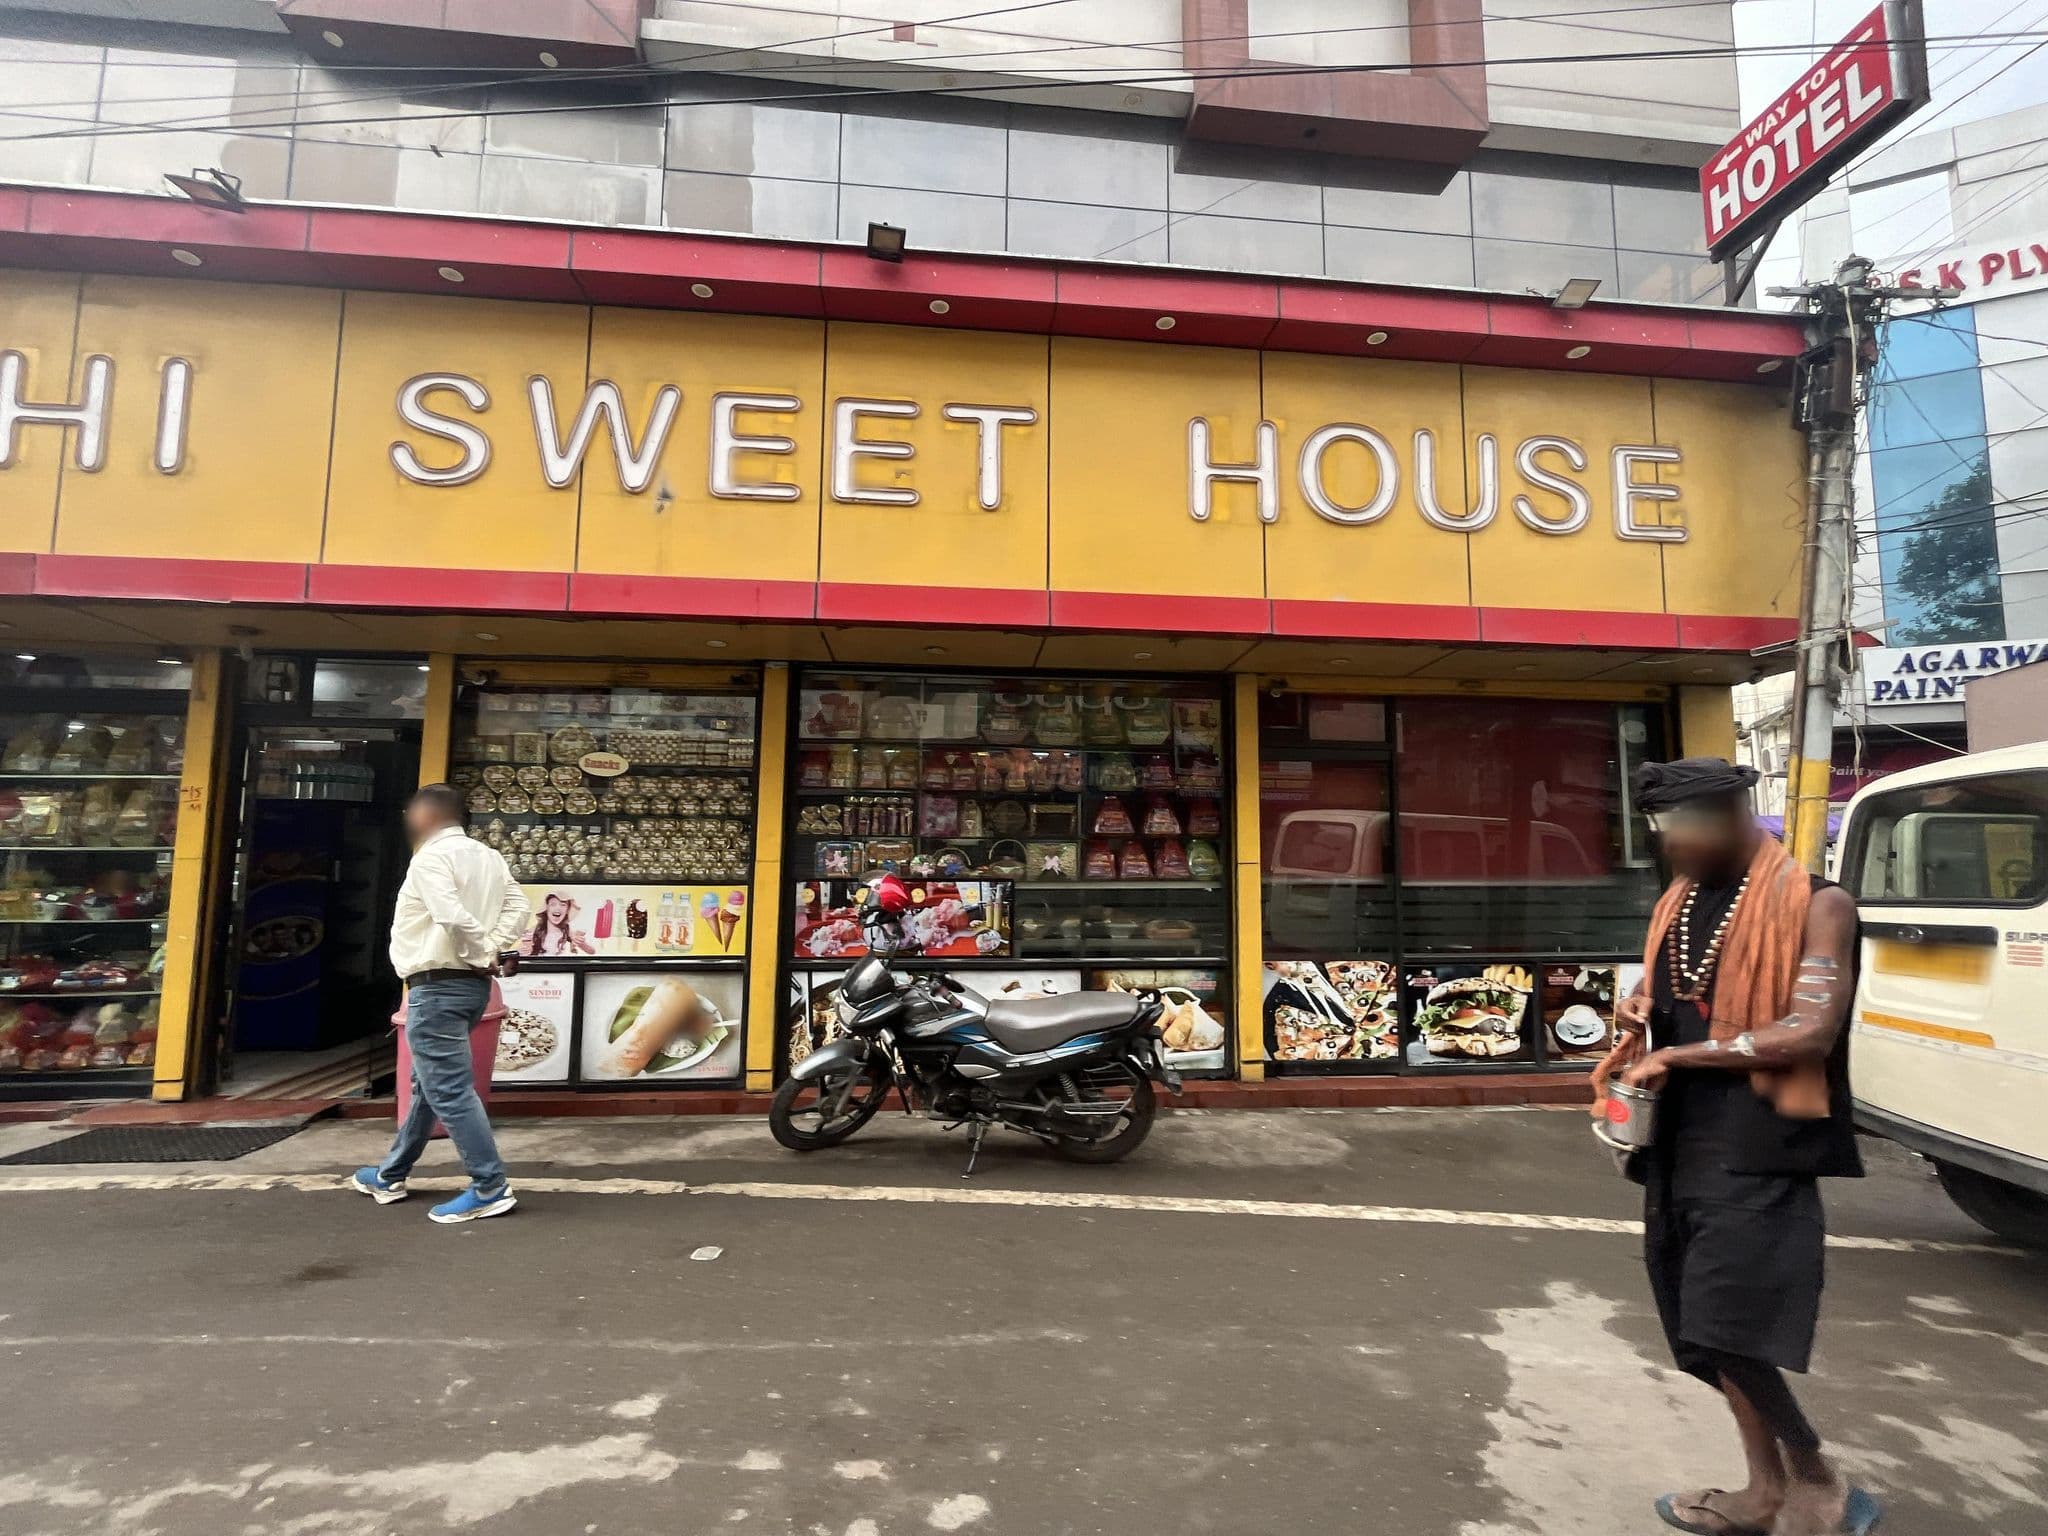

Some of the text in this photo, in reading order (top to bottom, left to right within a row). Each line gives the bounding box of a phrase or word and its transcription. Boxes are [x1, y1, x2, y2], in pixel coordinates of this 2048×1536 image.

[1708, 62, 1883, 235] HOTEL
[1745, 68, 1827, 147] WAY TO
[1938, 260, 1966, 291] K
[0, 349, 1689, 543] HI SWEET HOUSE
